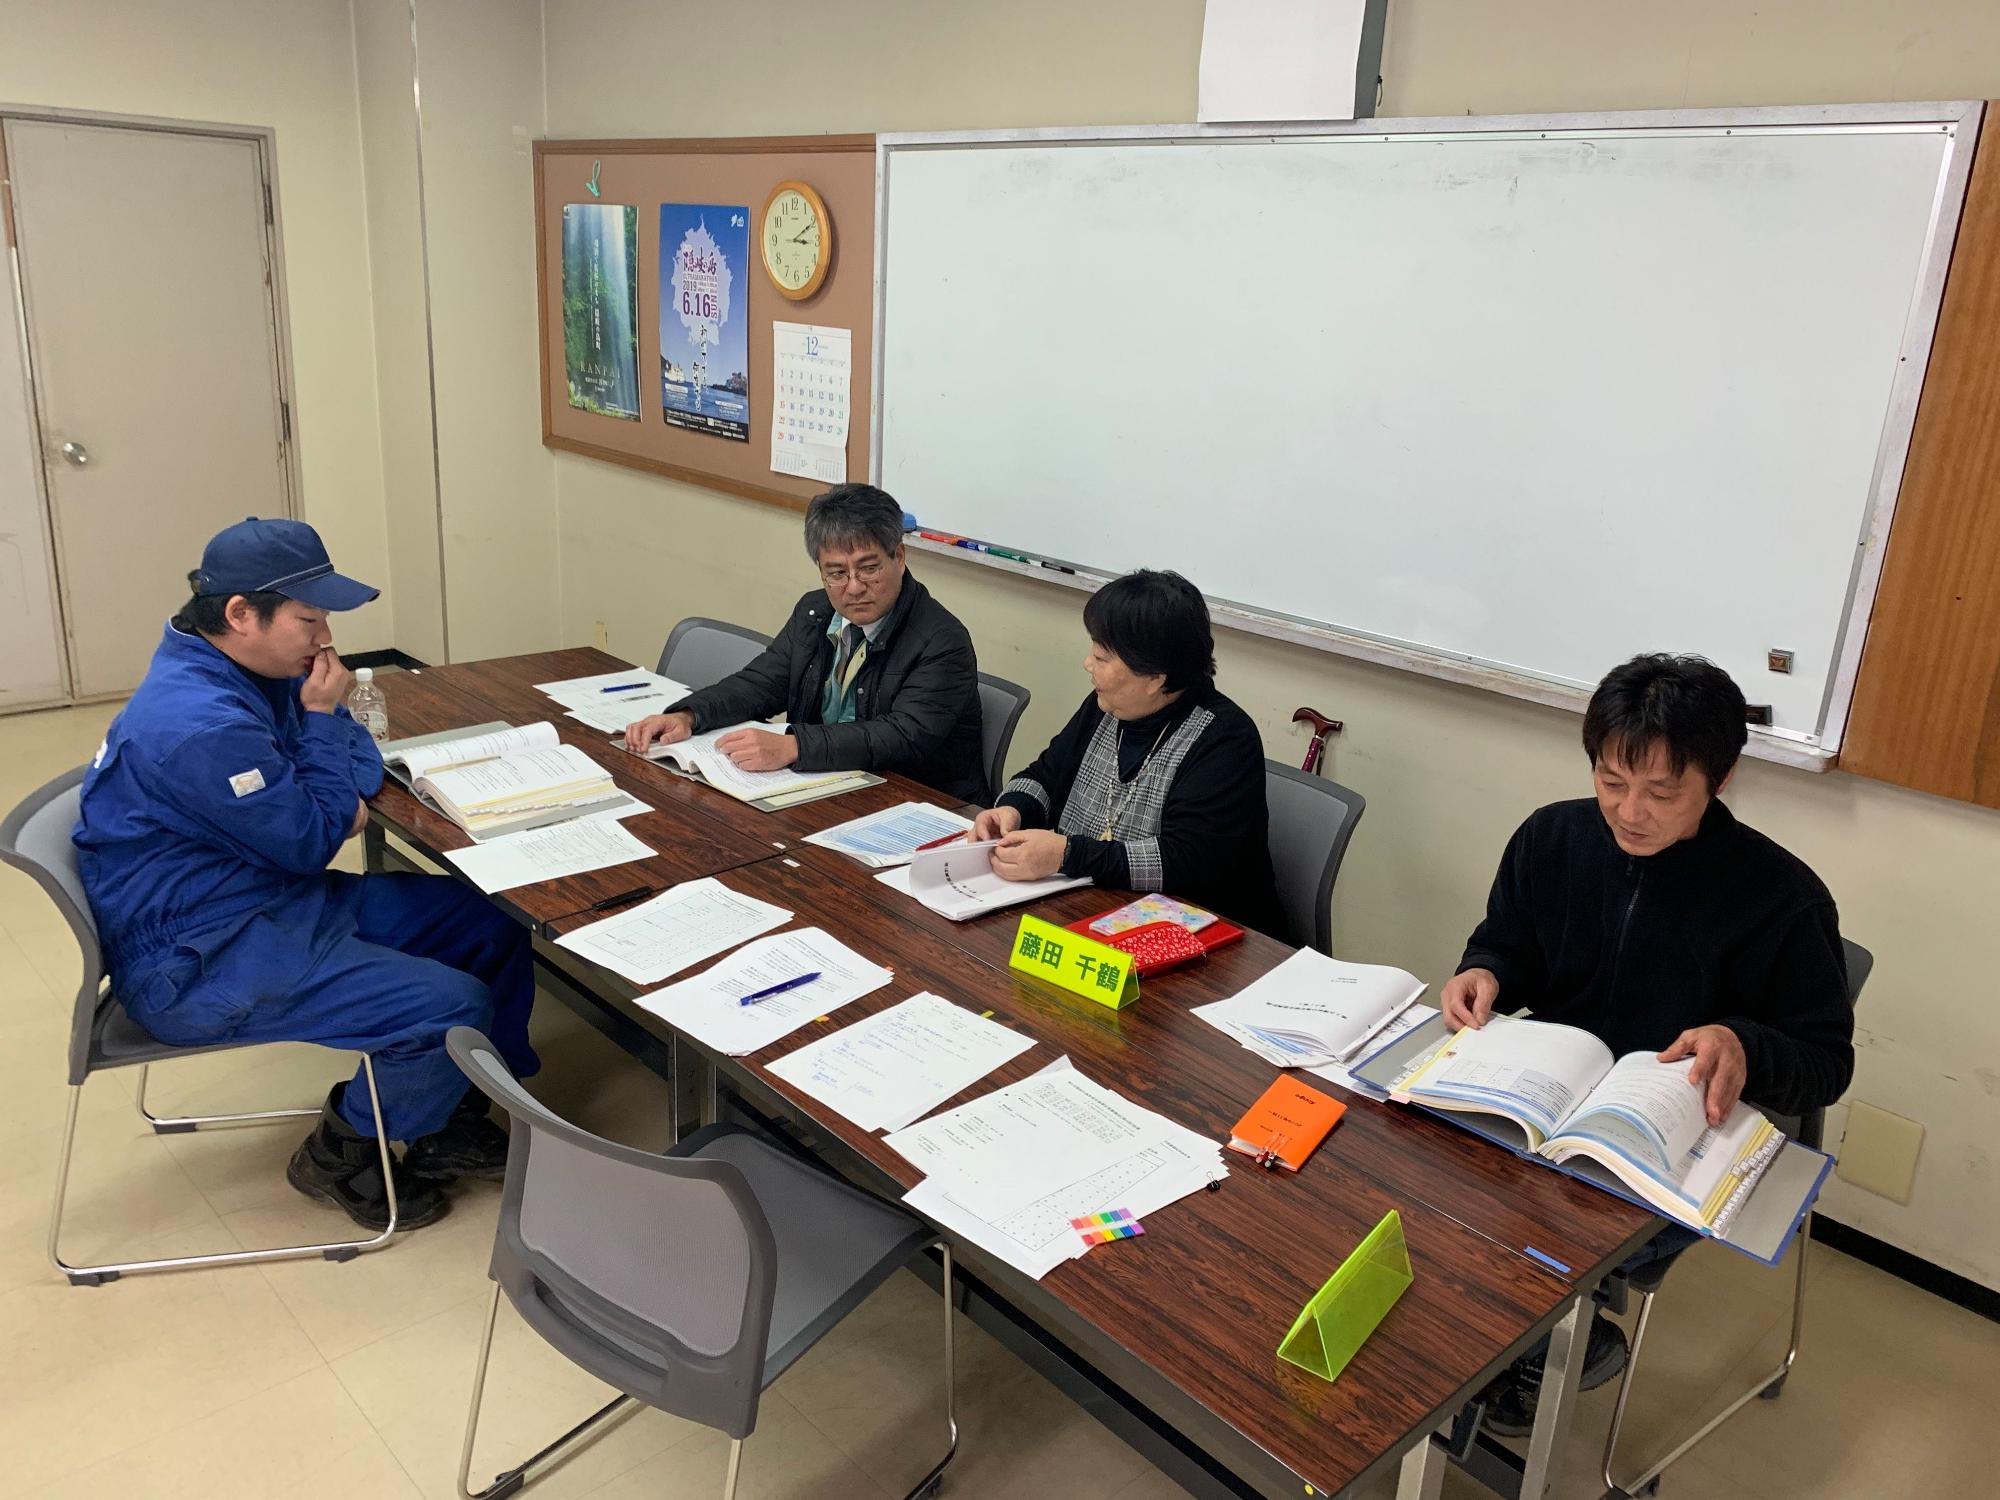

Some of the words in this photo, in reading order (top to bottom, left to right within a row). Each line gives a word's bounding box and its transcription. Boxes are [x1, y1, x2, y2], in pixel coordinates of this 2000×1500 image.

[782, 202, 788, 215] 11
[791, 197, 799, 211] 12
[804, 202, 807, 215] 1
[774, 216, 782, 228] 10
[810, 215, 816, 228] 2
[772, 234, 778, 246] 9
[814, 234, 820, 247] 3
[776, 253, 782, 265] 8
[812, 253, 816, 265] 4
[785, 265, 790, 277] 7
[793, 270, 799, 282] 6
[804, 266, 810, 278] 5
[683, 280, 697, 292] 2019
[683, 291, 711, 318] 6.16
[805, 336, 819, 356] 12
[1018, 931, 1063, 969] 藤田
[1075, 953, 1121, 992] 千鶴
